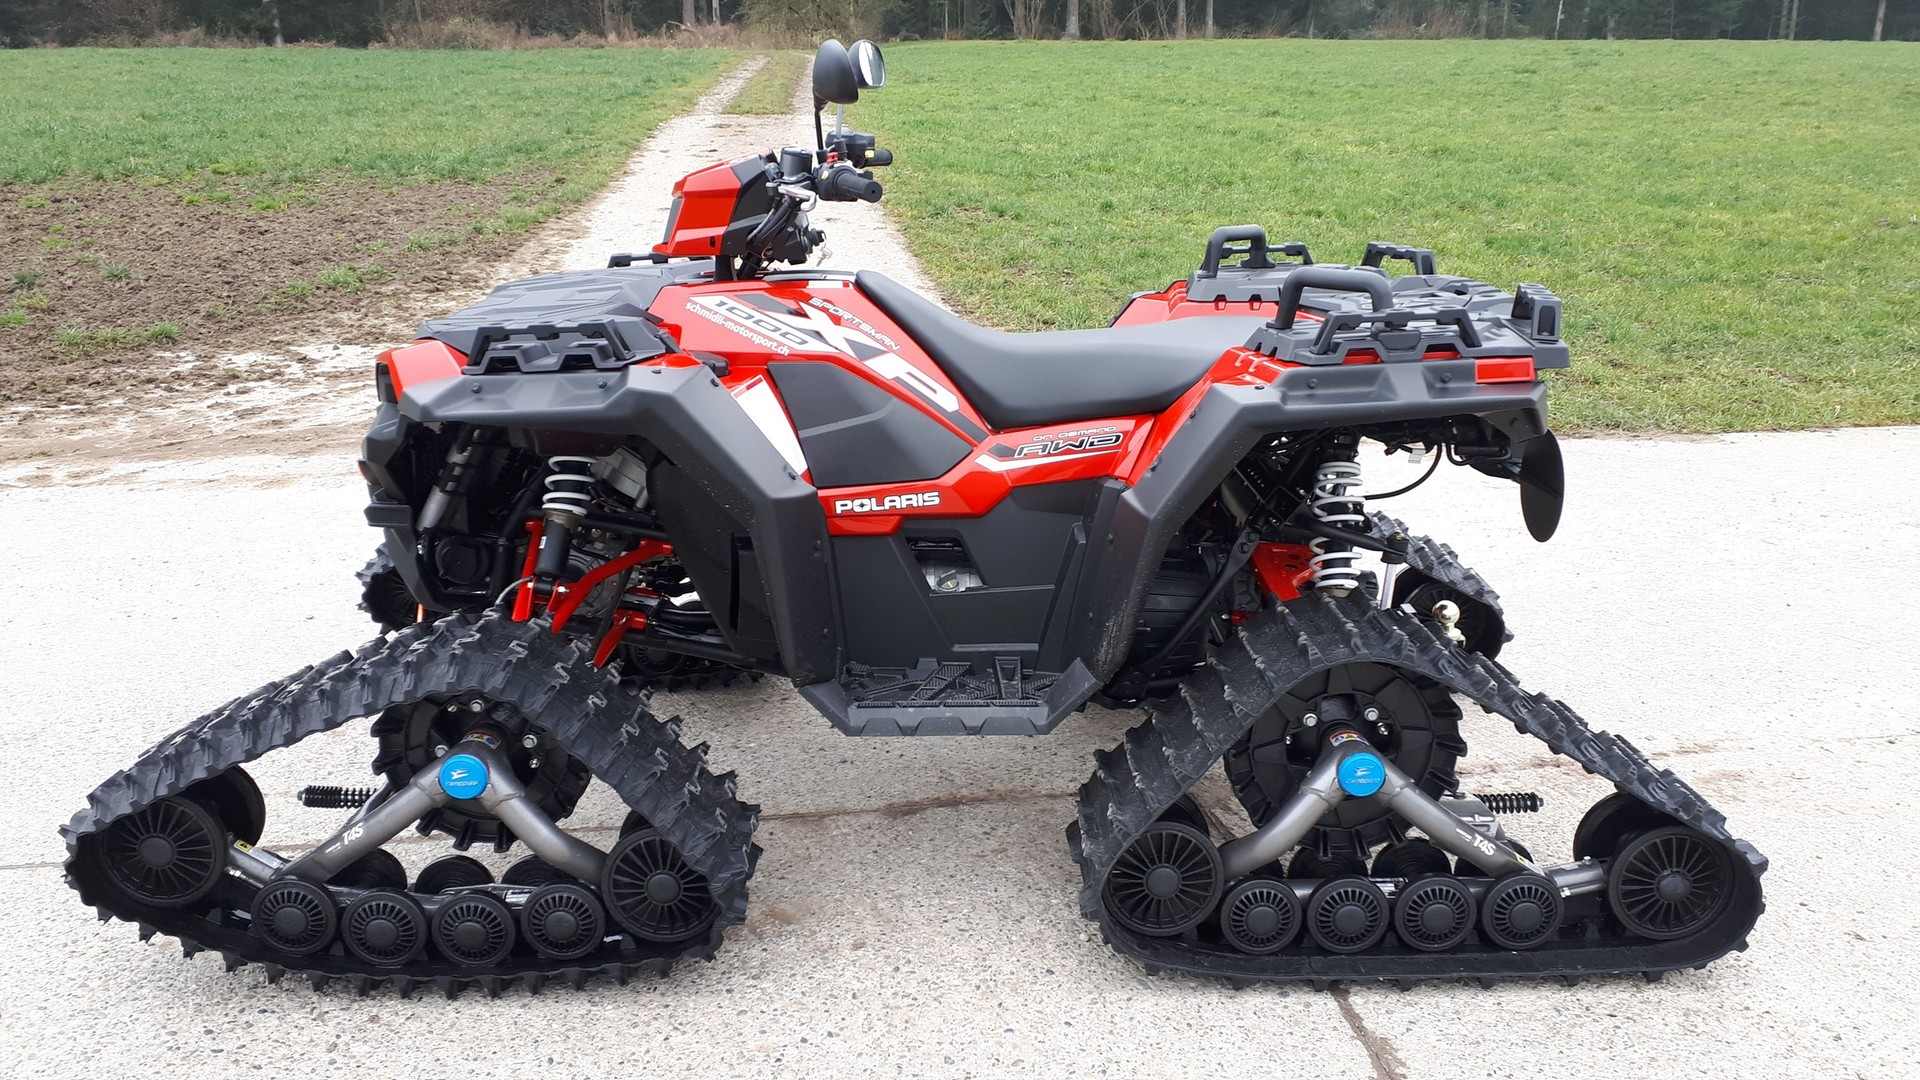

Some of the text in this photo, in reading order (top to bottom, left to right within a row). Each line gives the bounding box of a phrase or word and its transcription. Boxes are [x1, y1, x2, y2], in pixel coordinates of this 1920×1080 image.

[685, 302, 790, 355] schmidli-motorsport.ch
[715, 300, 809, 345] 1000
[808, 297, 901, 351] SPORTSMAN
[1058, 426, 1117, 438] DEMAND
[1014, 433, 1124, 458] AWD
[835, 492, 940, 514] POLARIS
[342, 822, 364, 846] T4S
[1473, 833, 1496, 856] T4S
